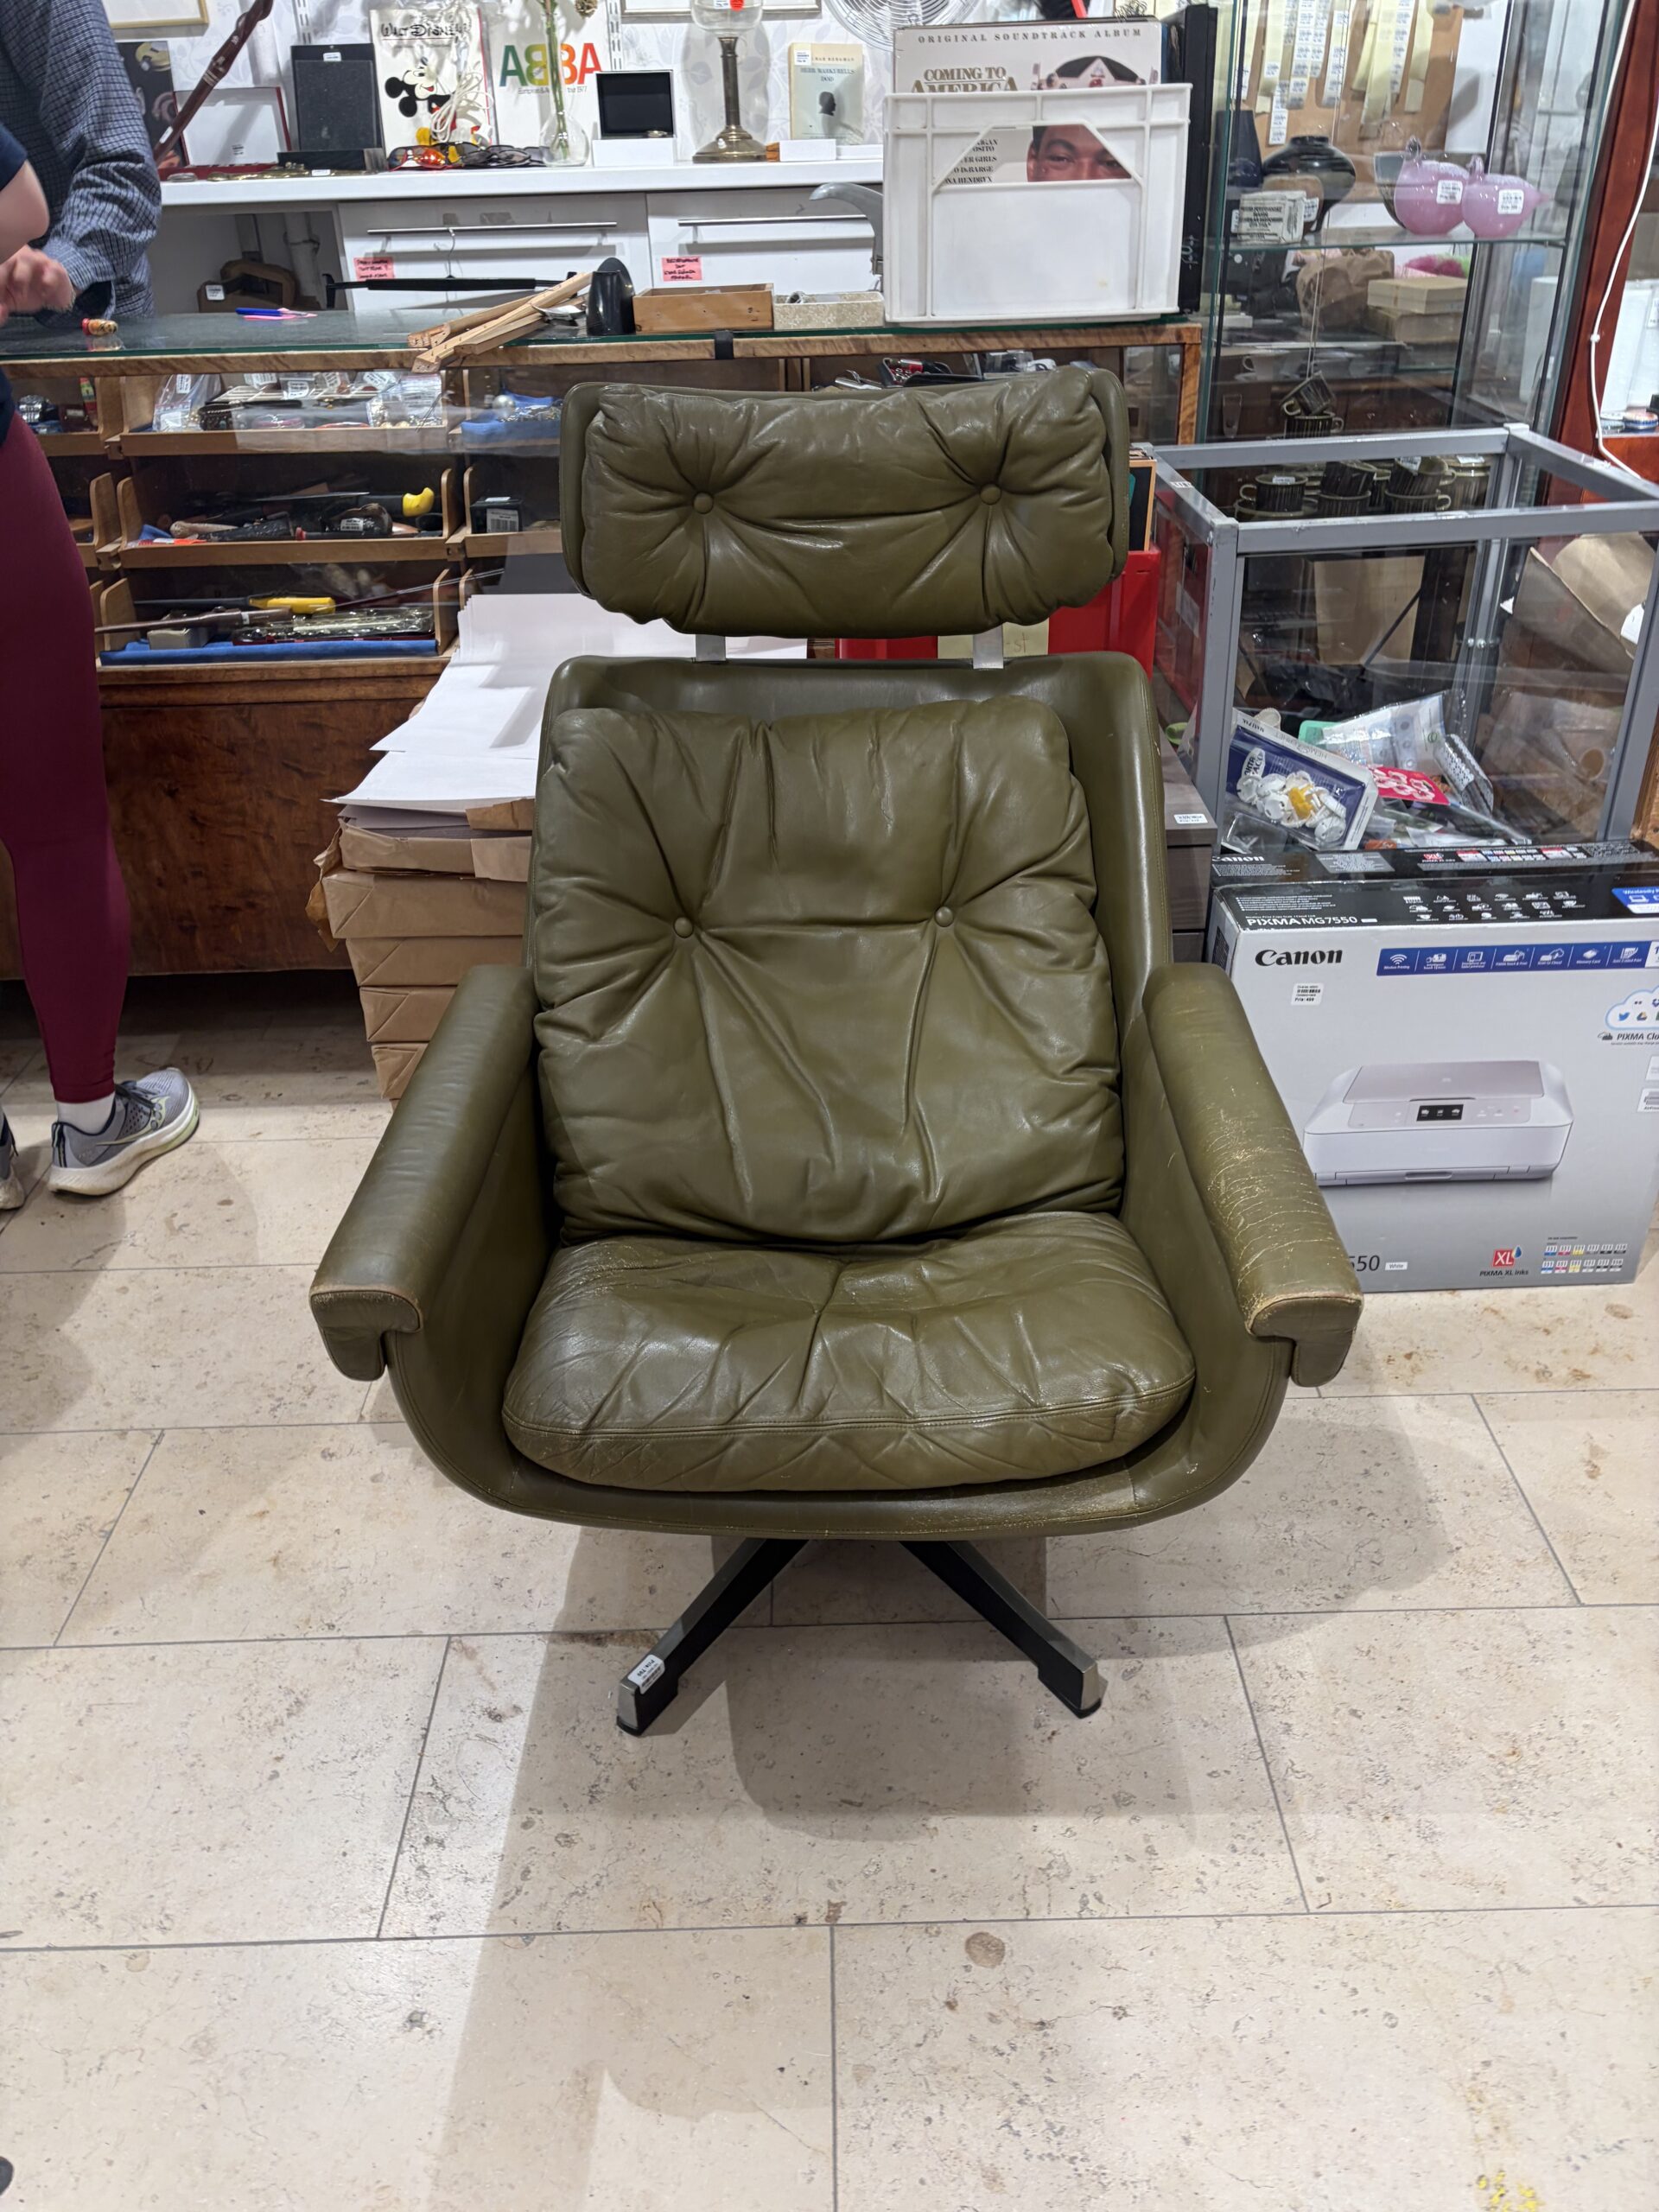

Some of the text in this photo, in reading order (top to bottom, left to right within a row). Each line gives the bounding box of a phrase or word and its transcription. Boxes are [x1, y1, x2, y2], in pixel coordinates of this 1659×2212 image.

[918, 29, 1141, 43] ORIGINAL SOUNDTRACK ALBUM
[499, 43, 602, 86] ABBA
[924, 67, 1007, 81] COMING TO
[1255, 949, 1343, 966] Canon
[1495, 1251, 1513, 1265] XL
